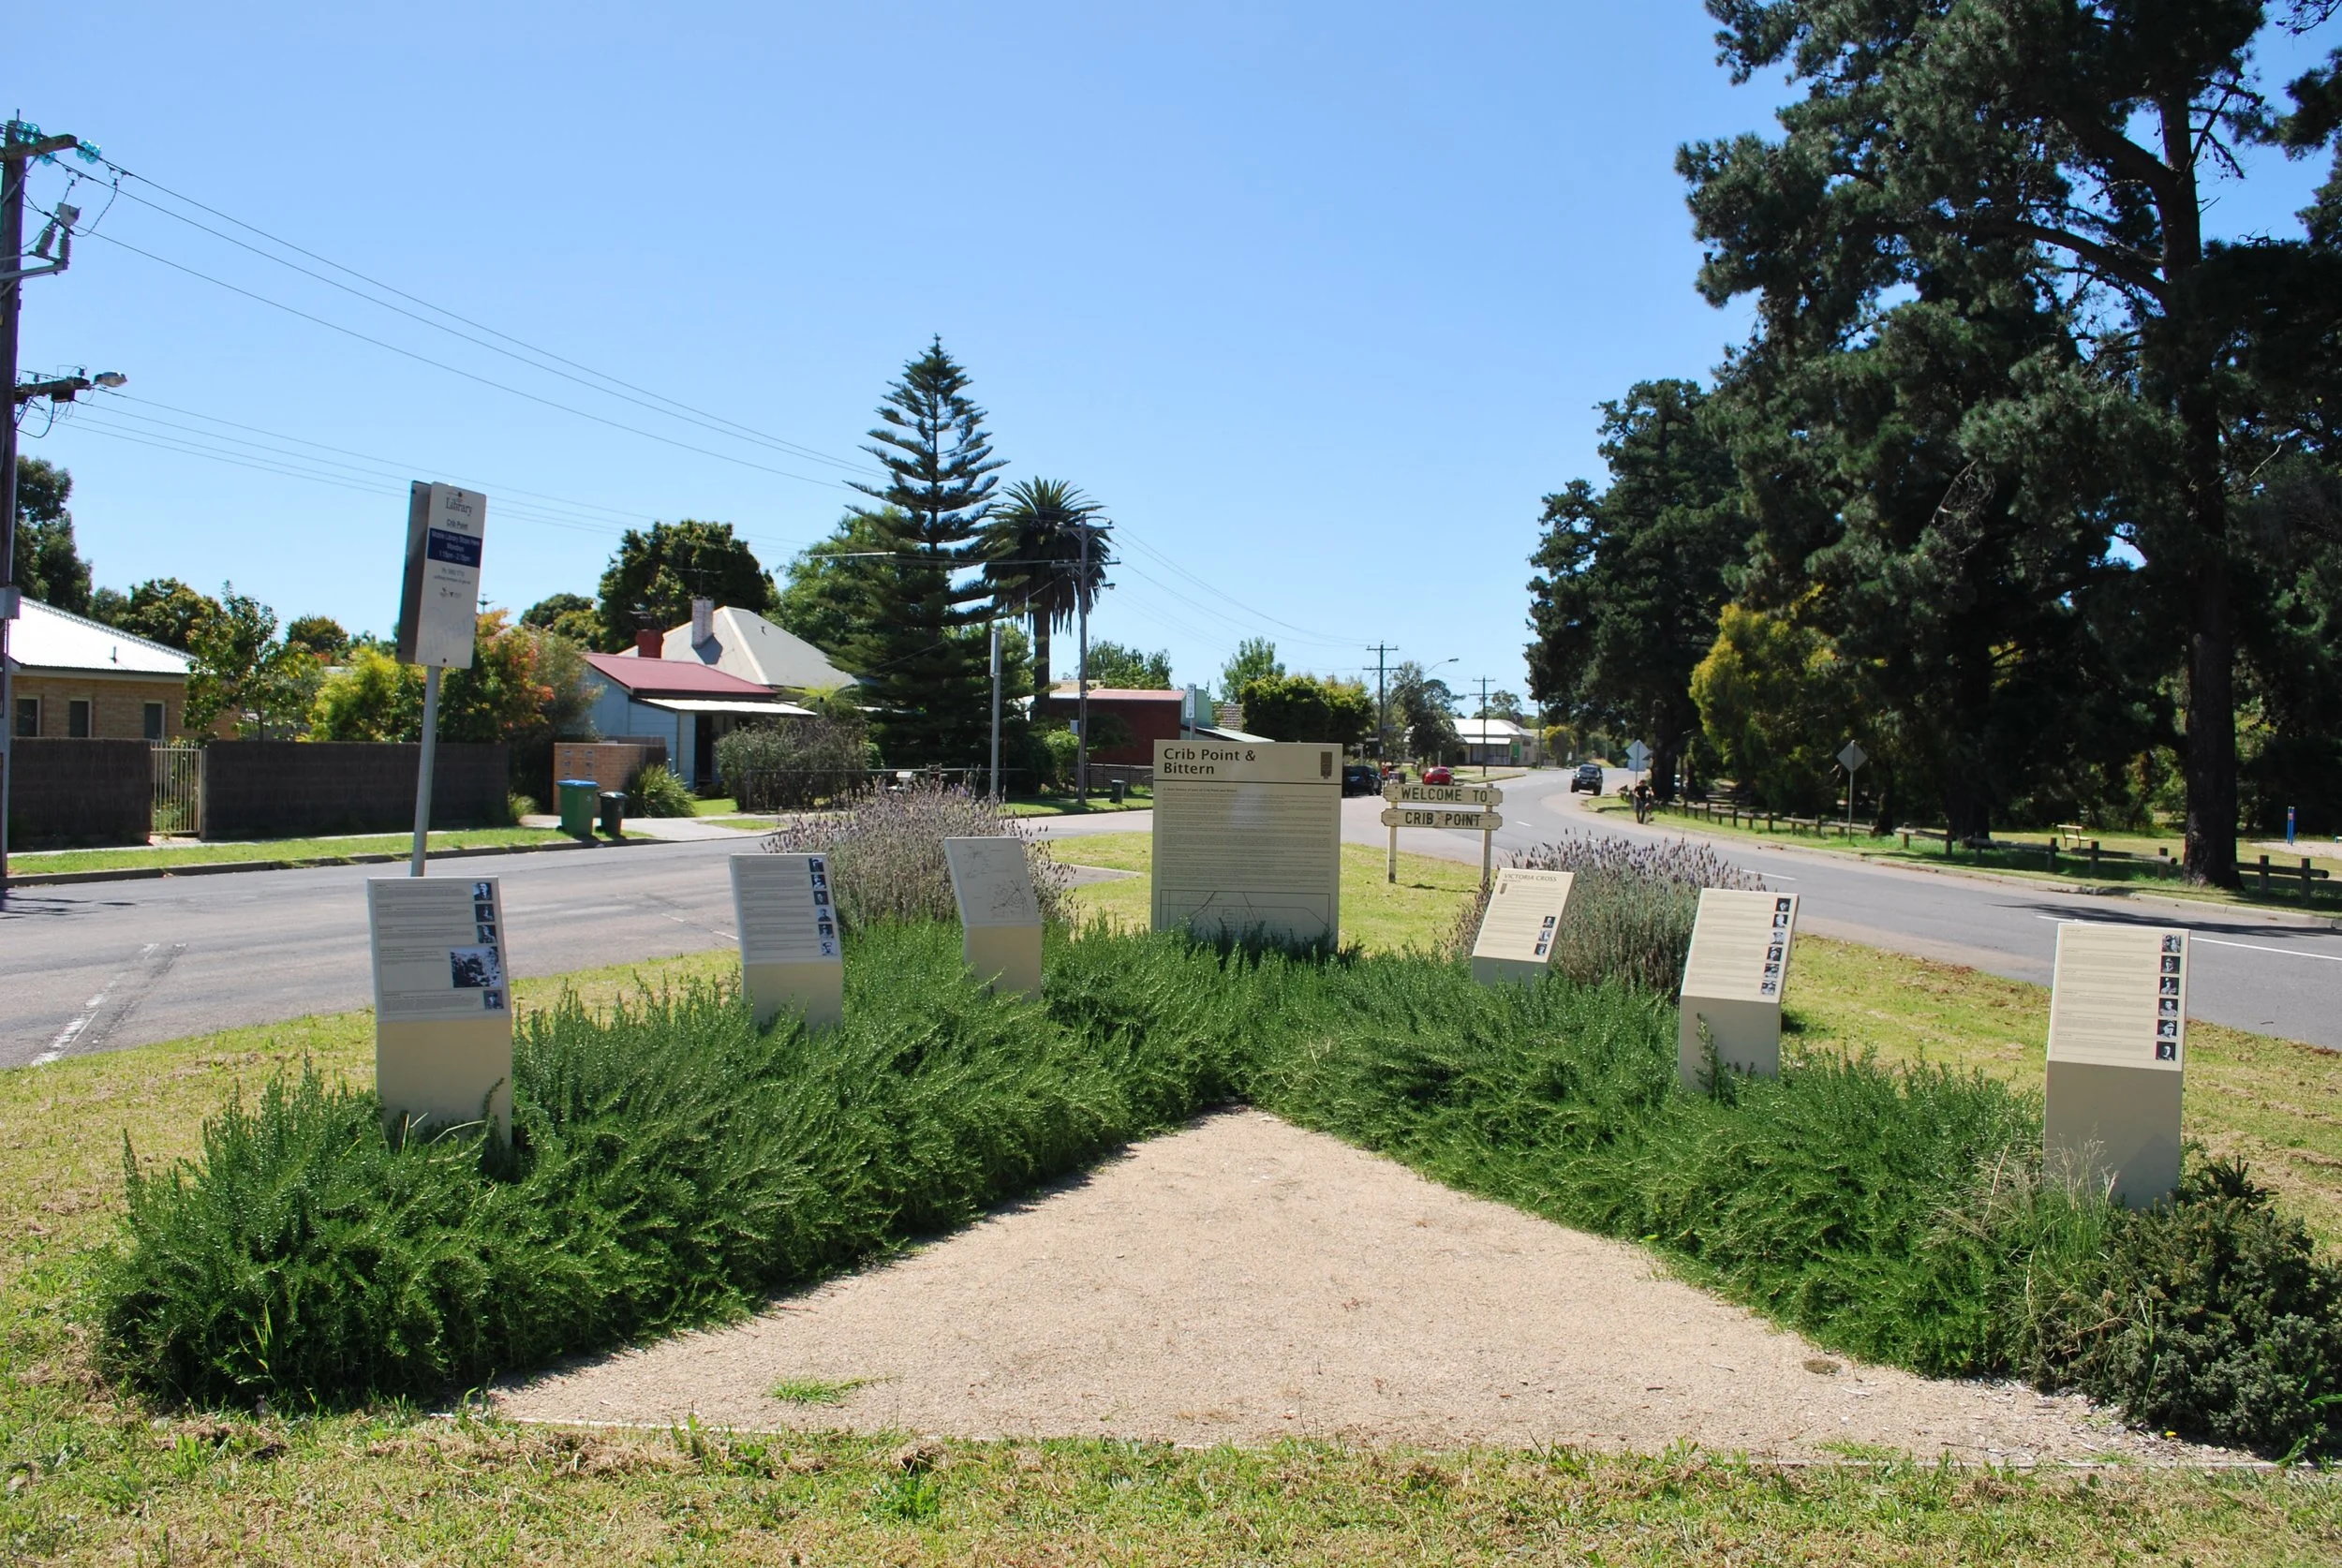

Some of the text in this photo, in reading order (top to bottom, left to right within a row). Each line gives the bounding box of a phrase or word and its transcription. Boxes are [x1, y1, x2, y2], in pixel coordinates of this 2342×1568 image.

[445, 496, 472, 517] Library
[1164, 747, 1255, 762] Crib Point &
[1164, 762, 1215, 775] Bittern
[1401, 787, 1488, 803] WELCOME TO
[1405, 811, 1481, 827] CRIB POINT
[1505, 873, 1534, 881] VICTORIA
